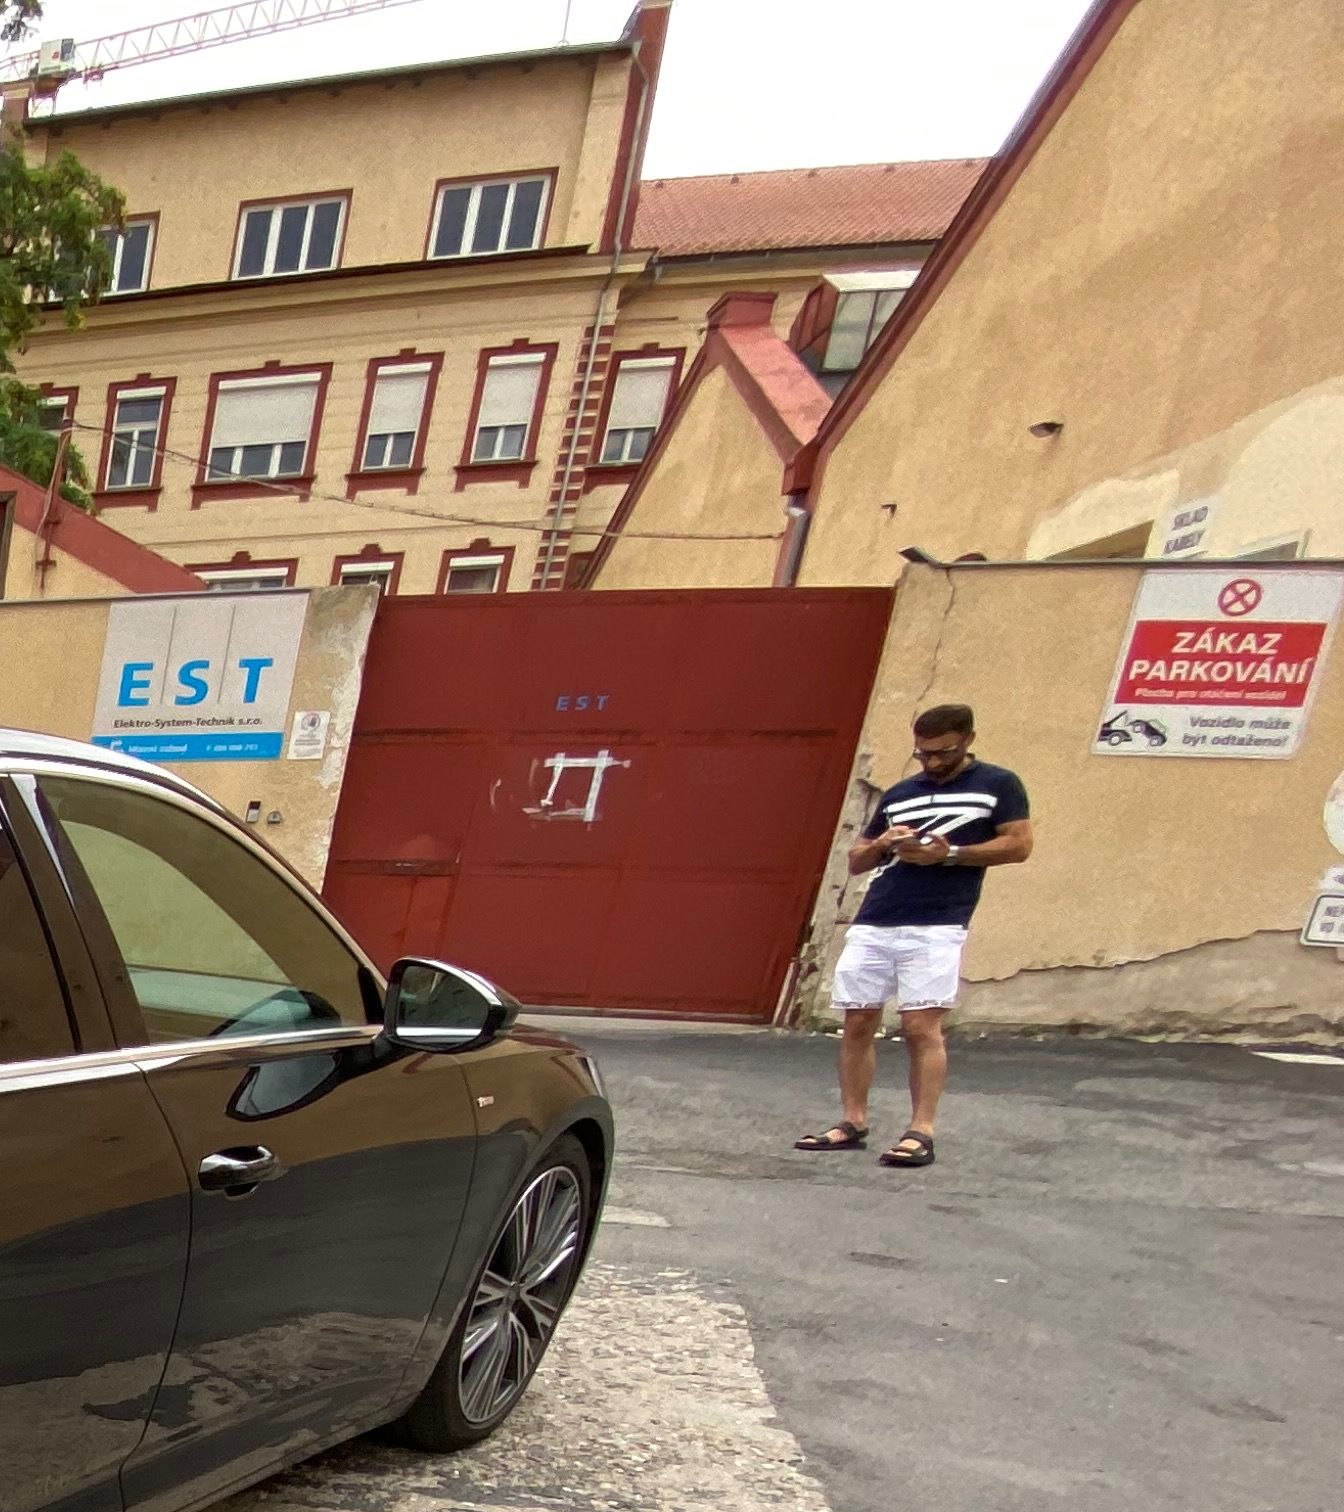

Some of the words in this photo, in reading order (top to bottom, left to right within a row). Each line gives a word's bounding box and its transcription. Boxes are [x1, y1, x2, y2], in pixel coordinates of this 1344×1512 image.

[1172, 627, 1283, 654] ZÁKAZ
[1128, 657, 1314, 684] PARKOVÁNÍ
[113, 717, 235, 729] Elektro-System-Technik
[238, 717, 263, 726] s.r.o.
